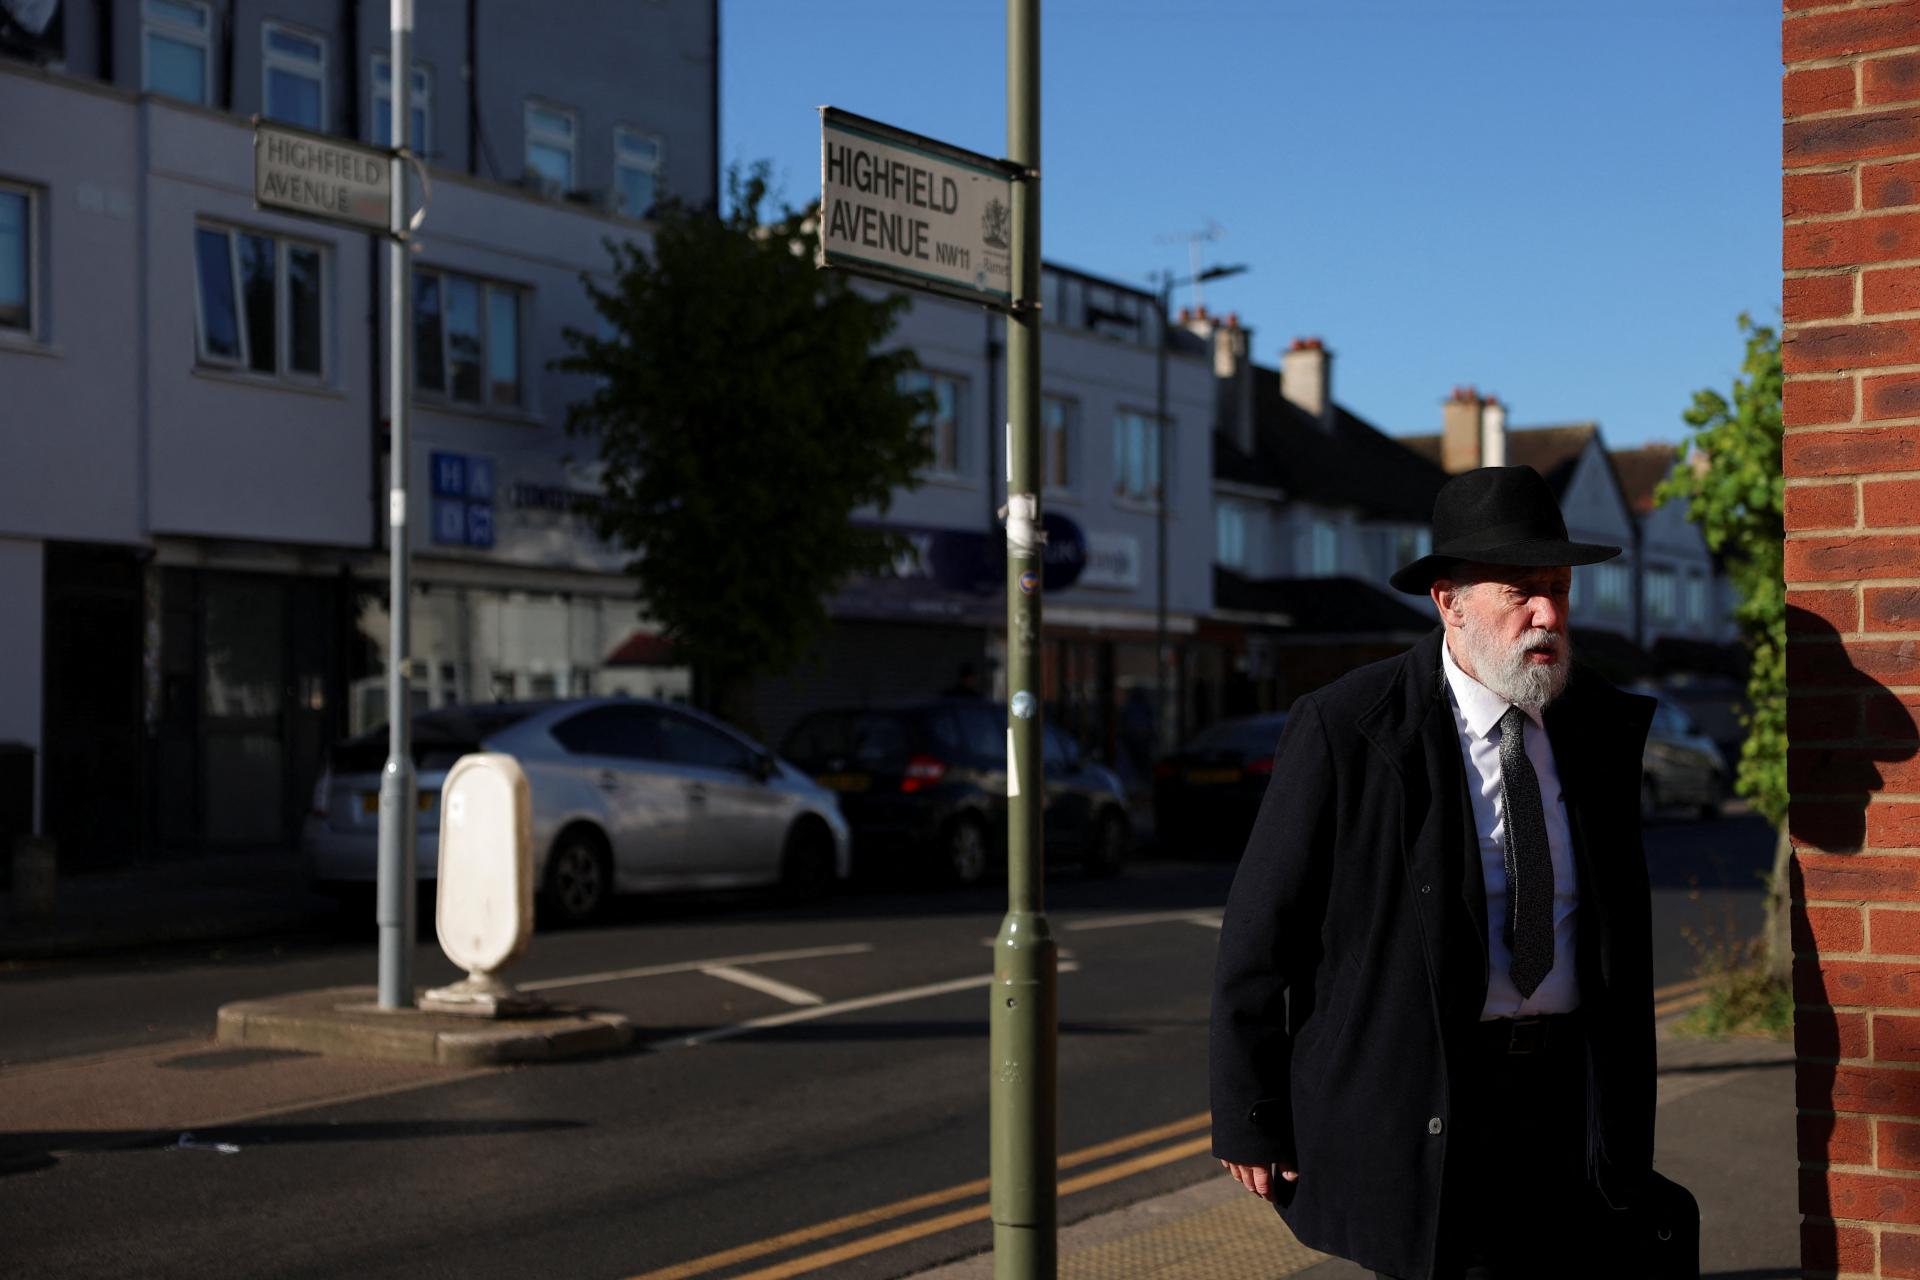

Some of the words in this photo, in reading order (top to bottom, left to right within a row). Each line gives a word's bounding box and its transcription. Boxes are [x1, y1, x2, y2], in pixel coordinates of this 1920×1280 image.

[268, 136, 380, 185] HIGHFIELD
[828, 142, 958, 215] HIGHFIELD
[263, 171, 349, 213] AVENUE
[830, 199, 929, 260] AVENUE
[936, 242, 970, 270] NW11
